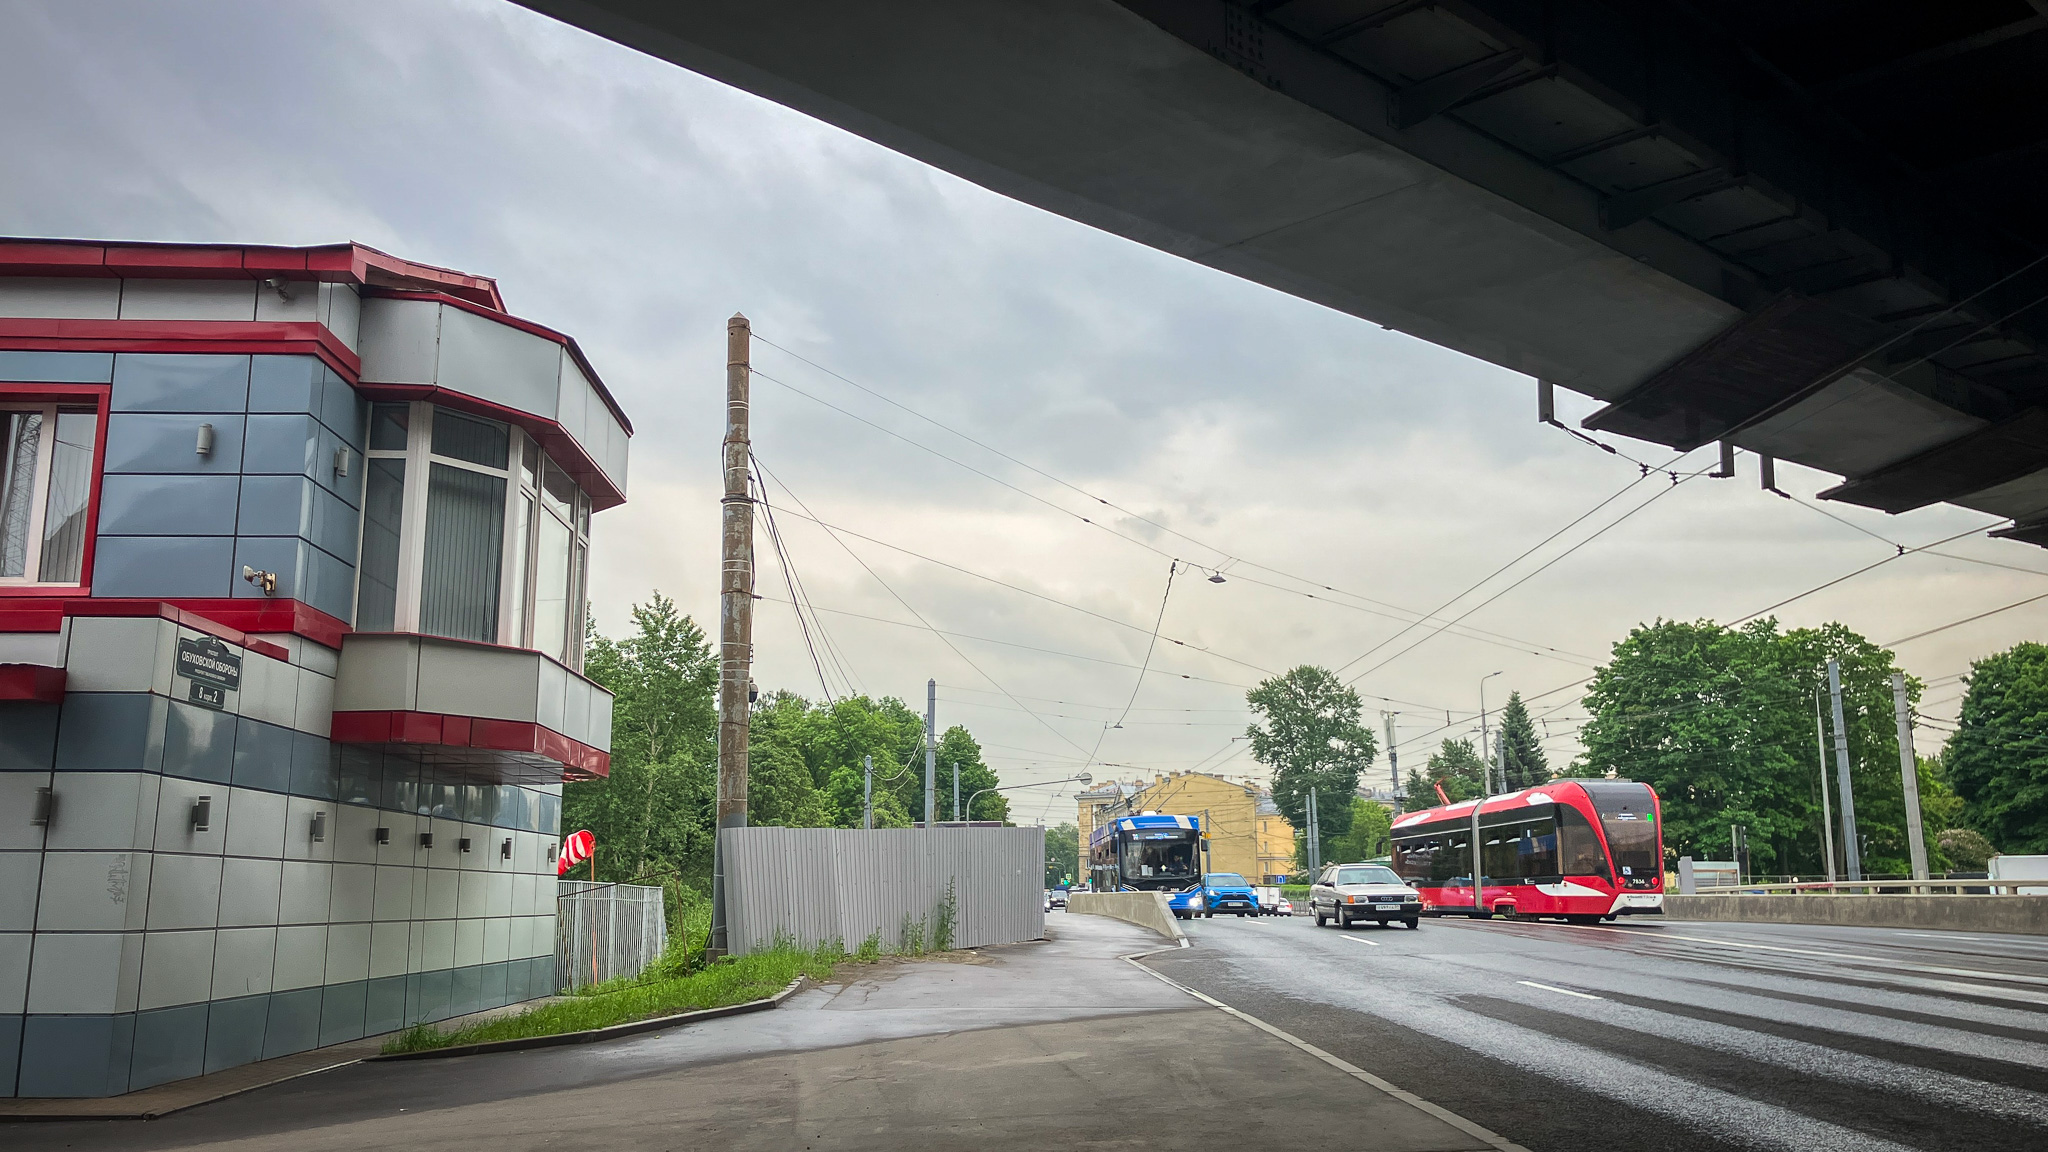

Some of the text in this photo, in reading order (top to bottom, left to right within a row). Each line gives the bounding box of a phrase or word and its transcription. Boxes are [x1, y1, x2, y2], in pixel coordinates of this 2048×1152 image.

[182, 650, 215, 670] ОБУХОВСКОЙ
[215, 661, 239, 677] ОБОРОНЫ
[199, 687, 204, 698] 8
[213, 690, 218, 702] 2
